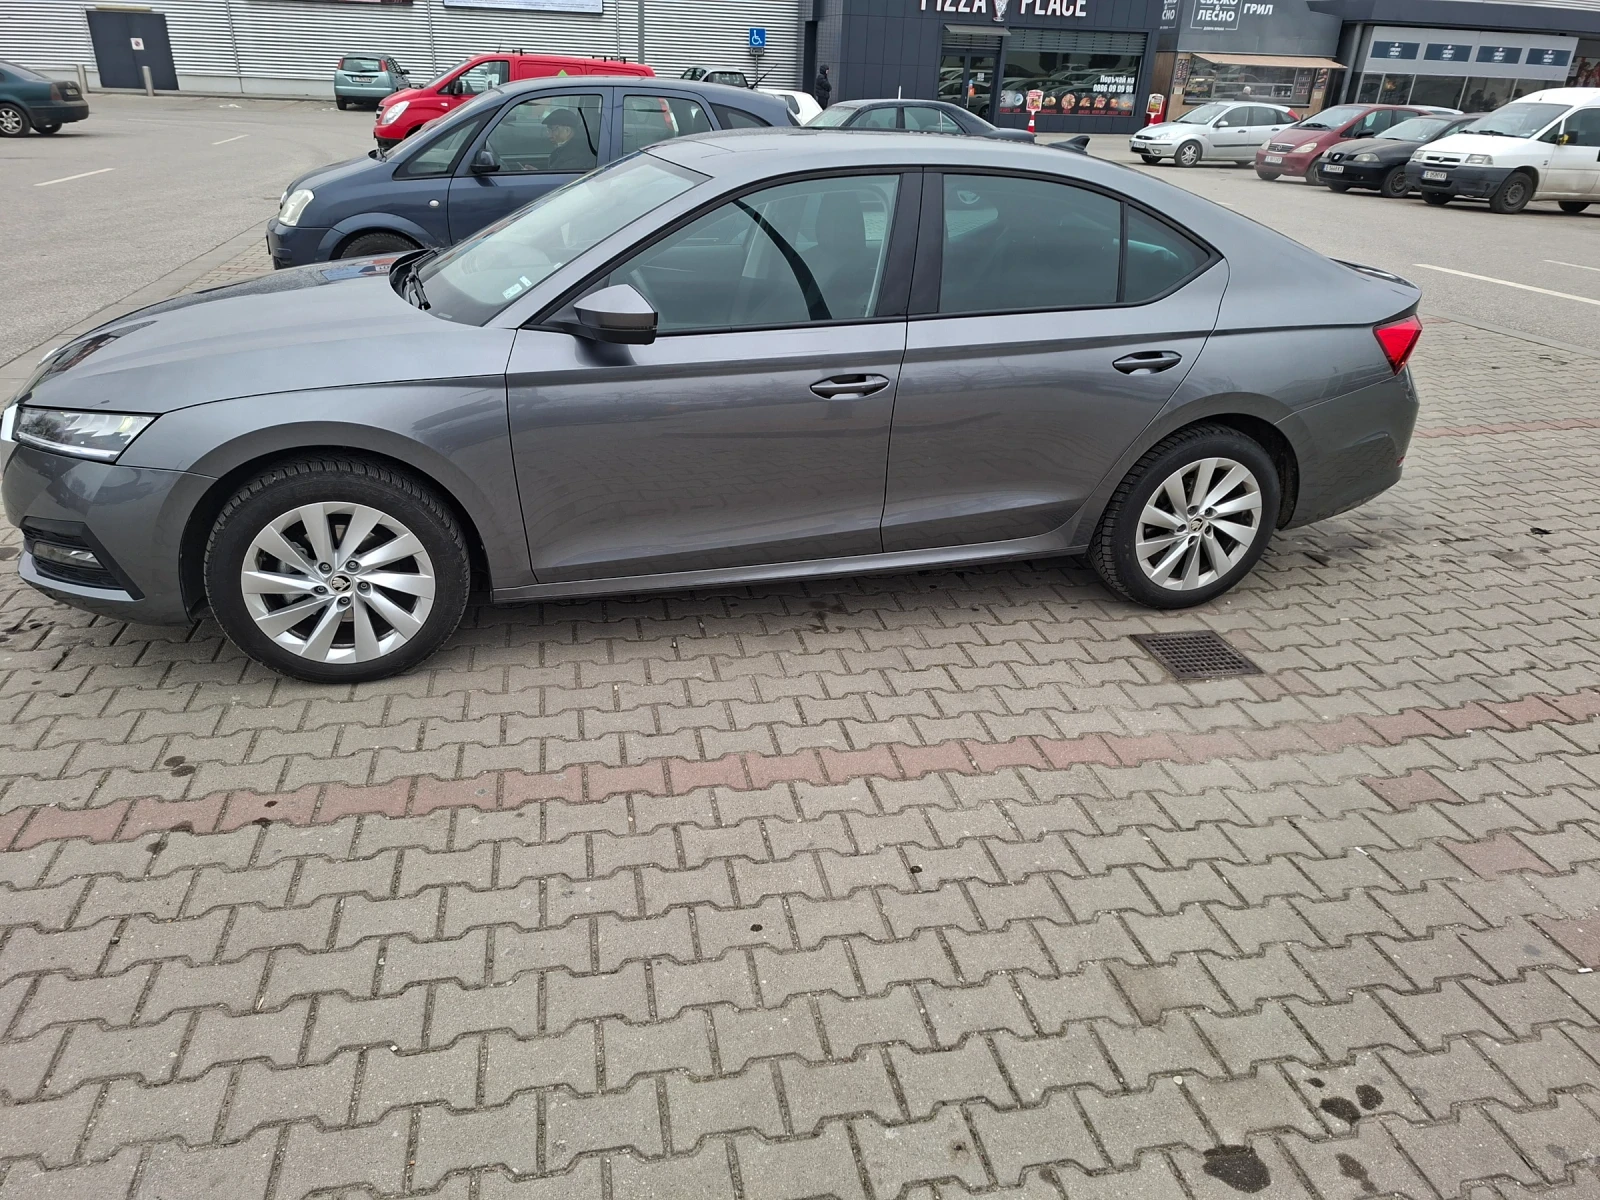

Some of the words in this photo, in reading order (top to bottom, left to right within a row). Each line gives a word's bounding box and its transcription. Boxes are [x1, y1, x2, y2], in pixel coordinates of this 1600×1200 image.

[1020, 0, 1087, 17] PLACE
[1243, 3, 1274, 15] ГРИЛ
[1197, 9, 1235, 22] ЛЕСНО
